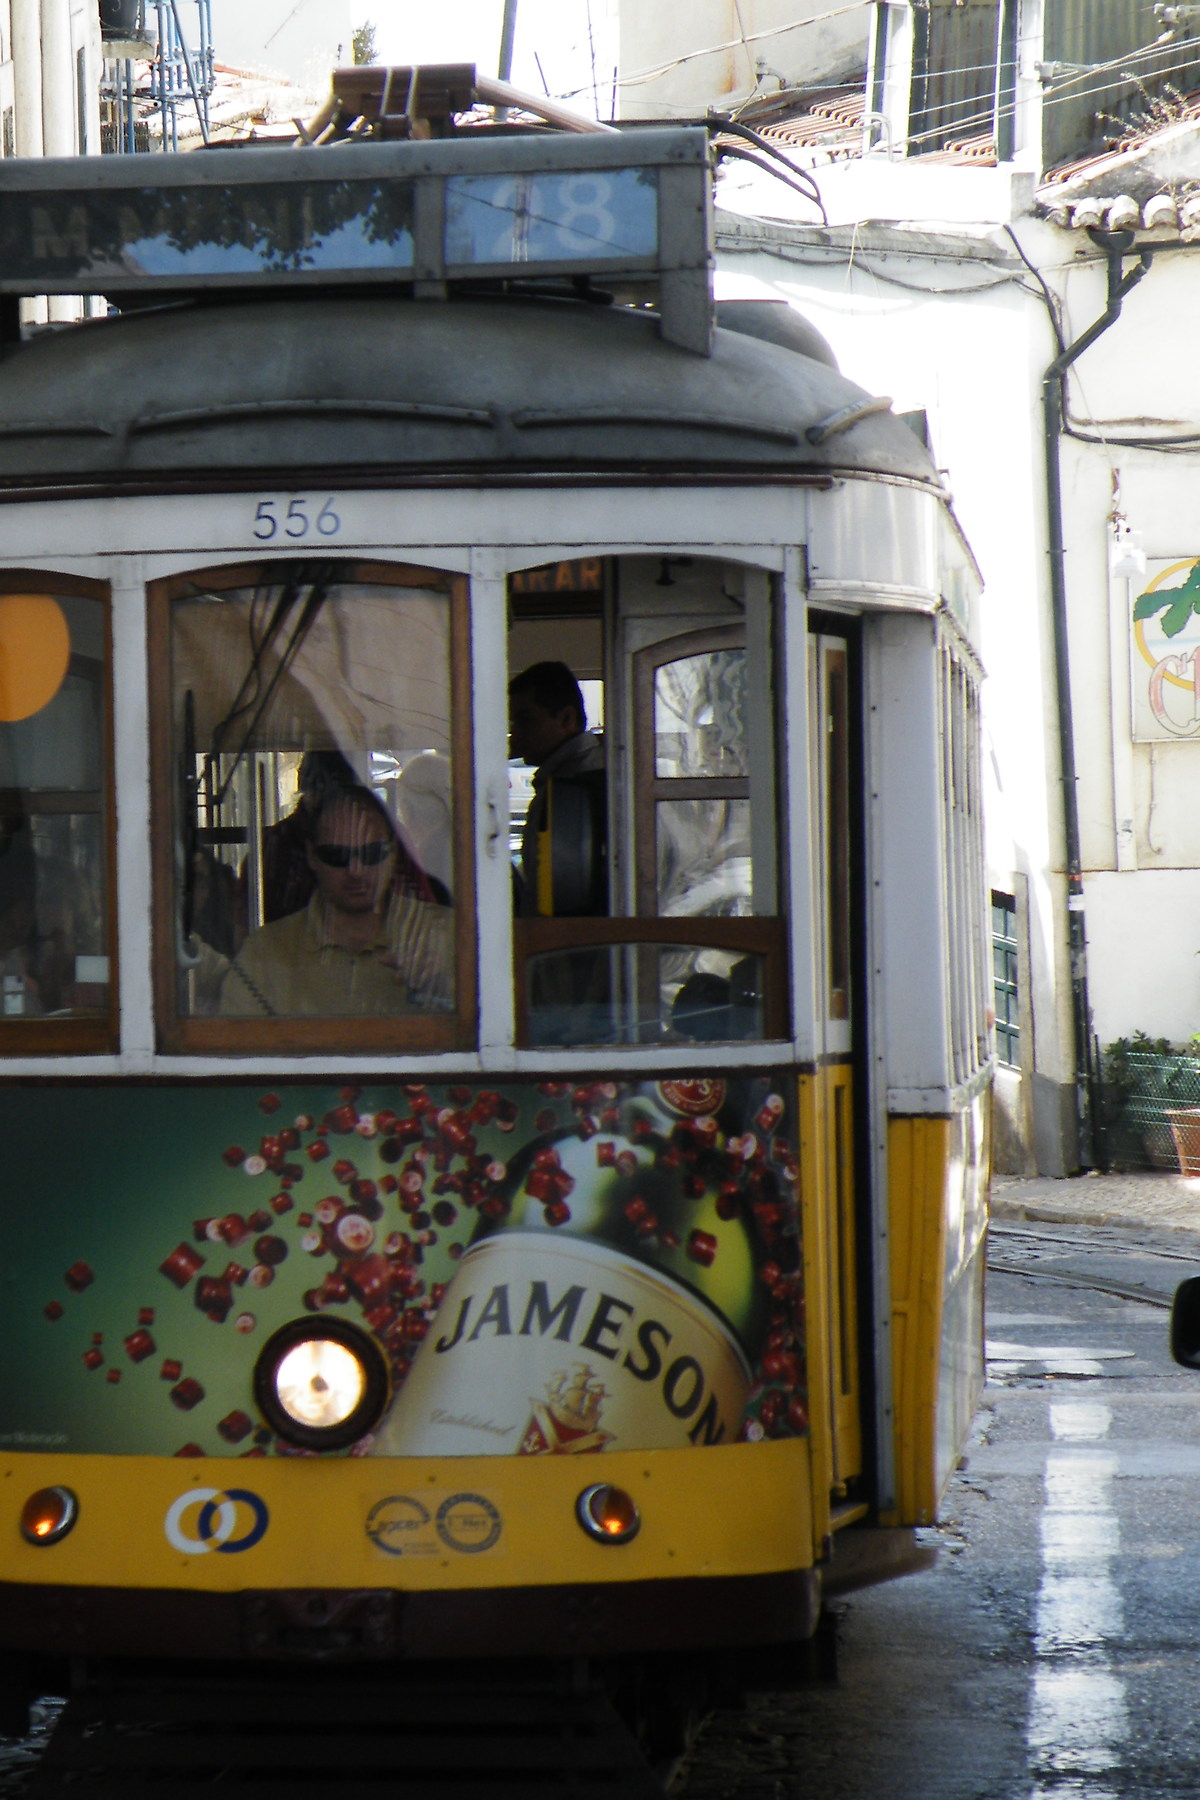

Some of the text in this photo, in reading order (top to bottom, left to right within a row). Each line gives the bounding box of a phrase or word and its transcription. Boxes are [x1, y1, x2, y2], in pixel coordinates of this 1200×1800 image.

[491, 174, 616, 258] 28
[253, 496, 341, 539] 556
[435, 1279, 726, 1448] JAMESON
